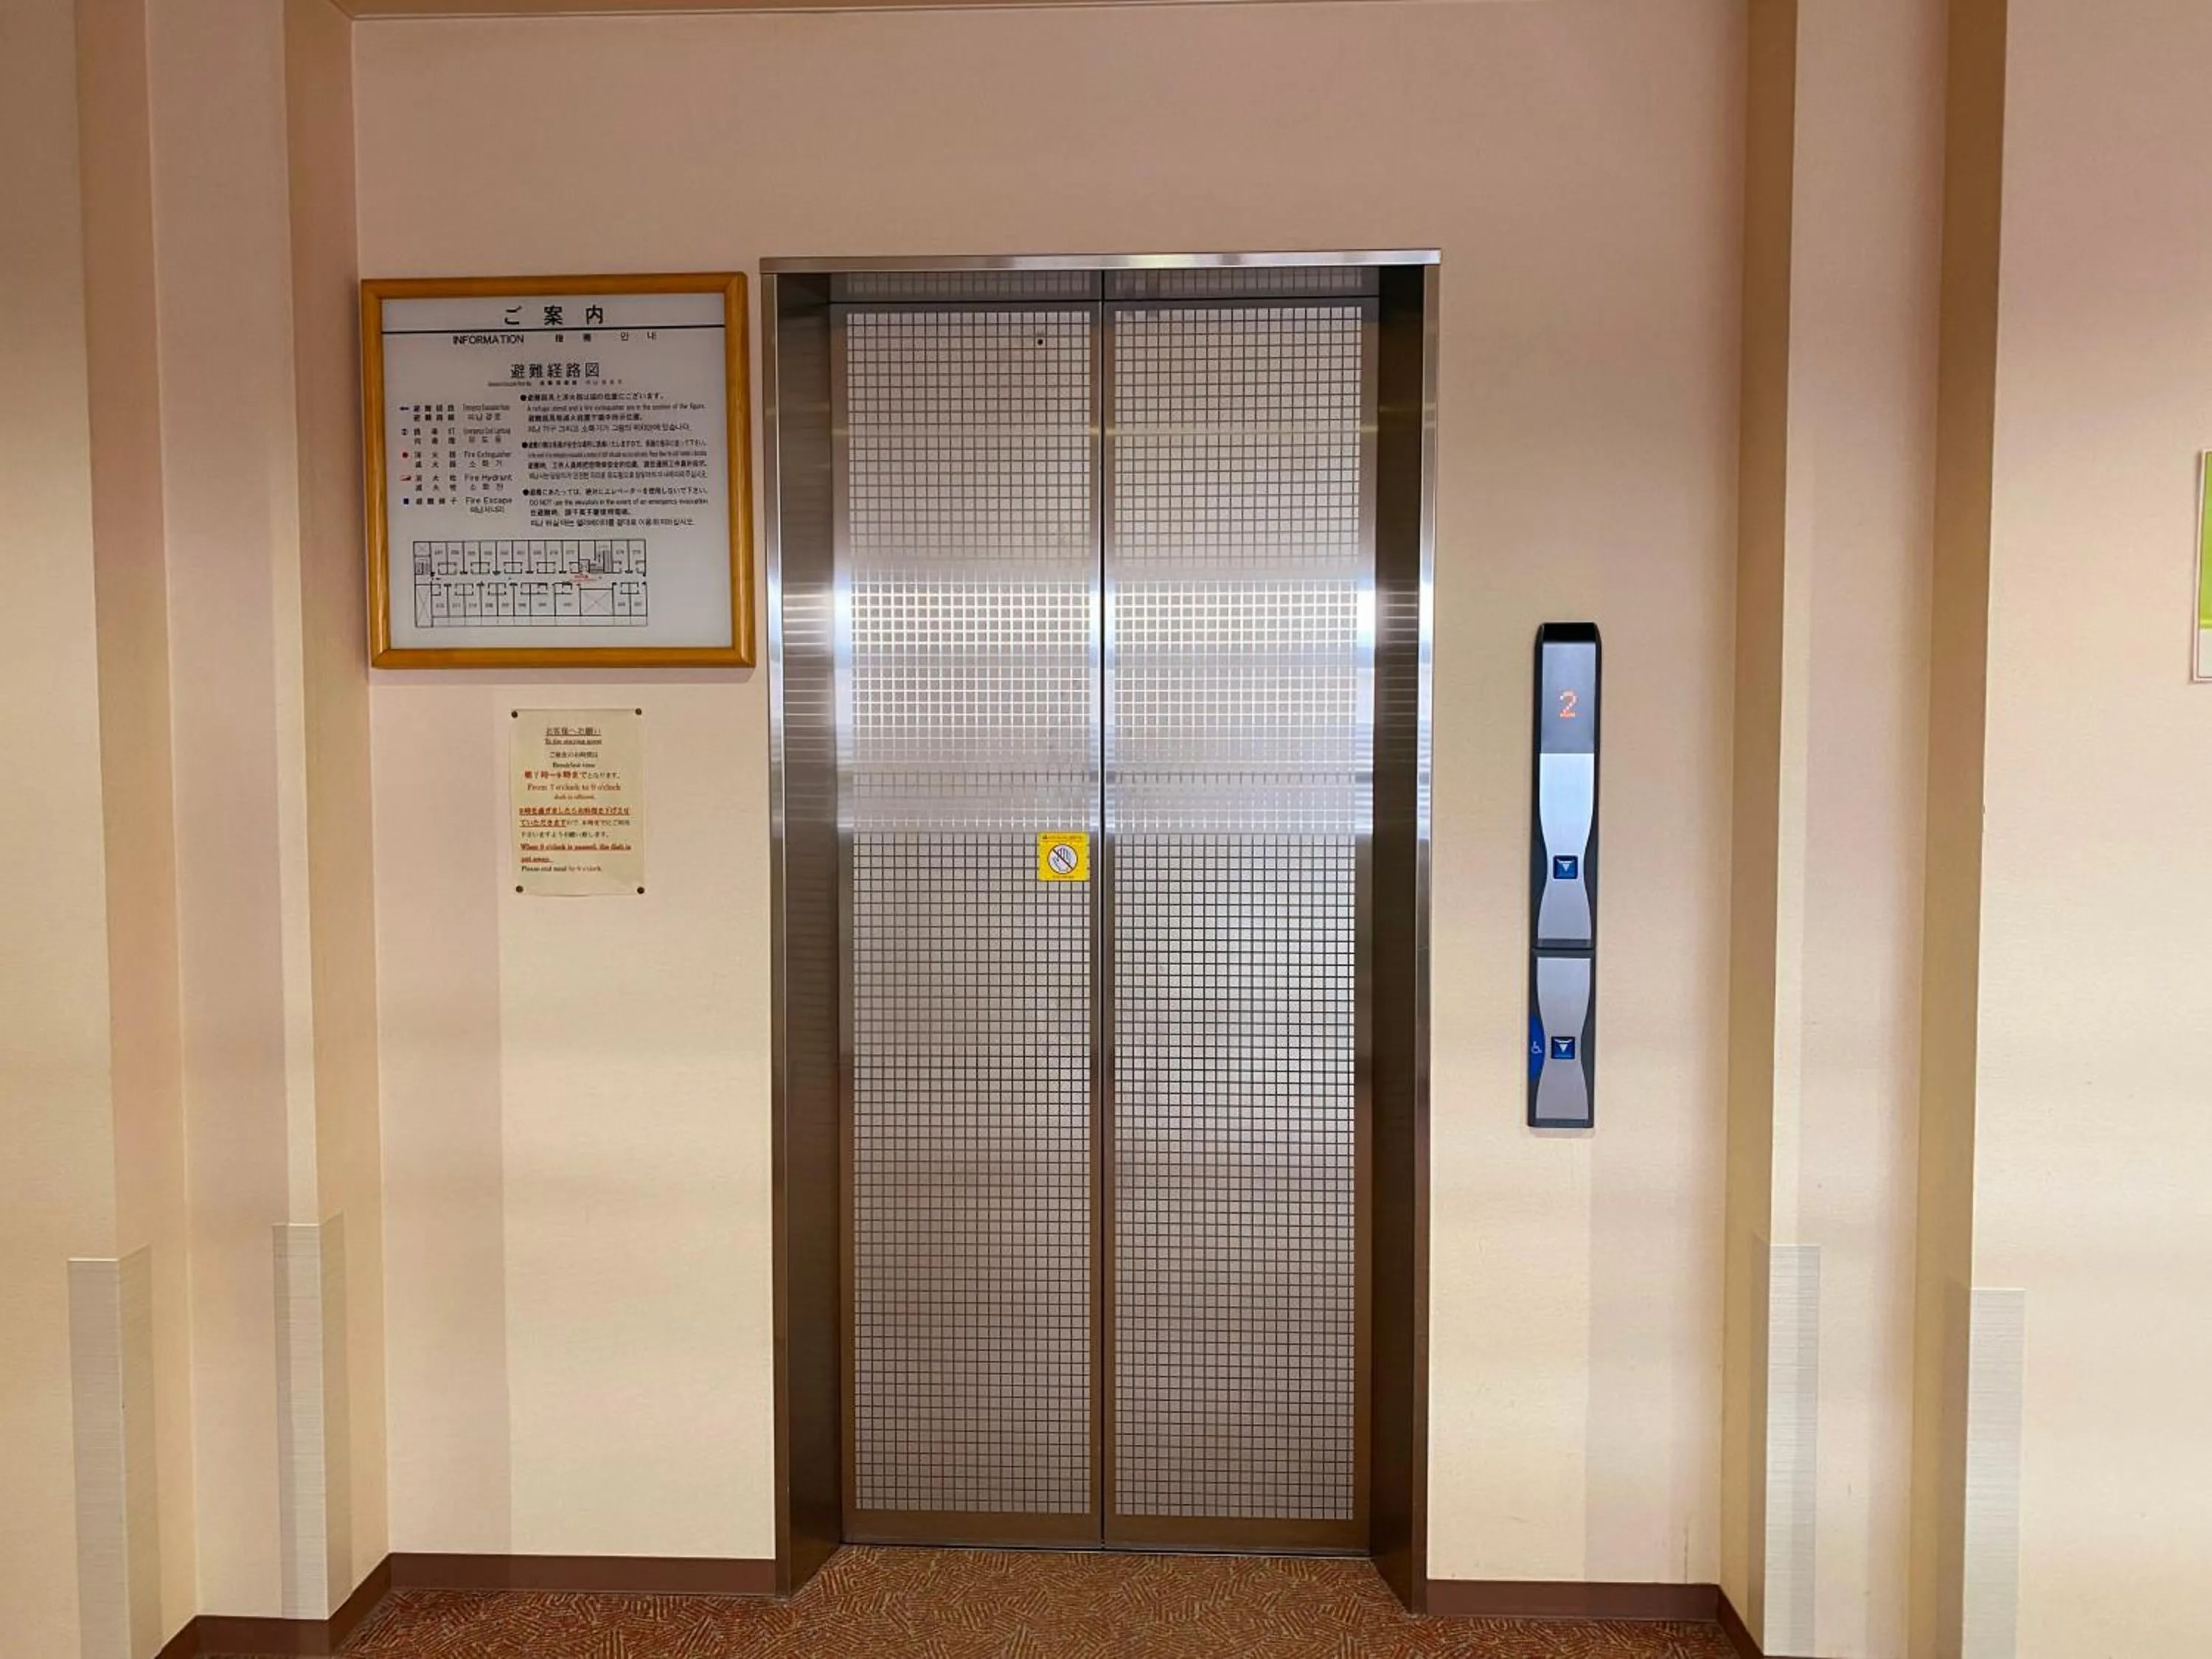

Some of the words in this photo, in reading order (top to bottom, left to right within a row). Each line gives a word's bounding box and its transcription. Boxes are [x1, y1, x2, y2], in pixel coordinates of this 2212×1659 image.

[504, 305, 604, 325] ご案内
[453, 334, 524, 344] INFORMATION
[510, 362, 599, 378] 避難経路図
[1559, 690, 1576, 718] 2
